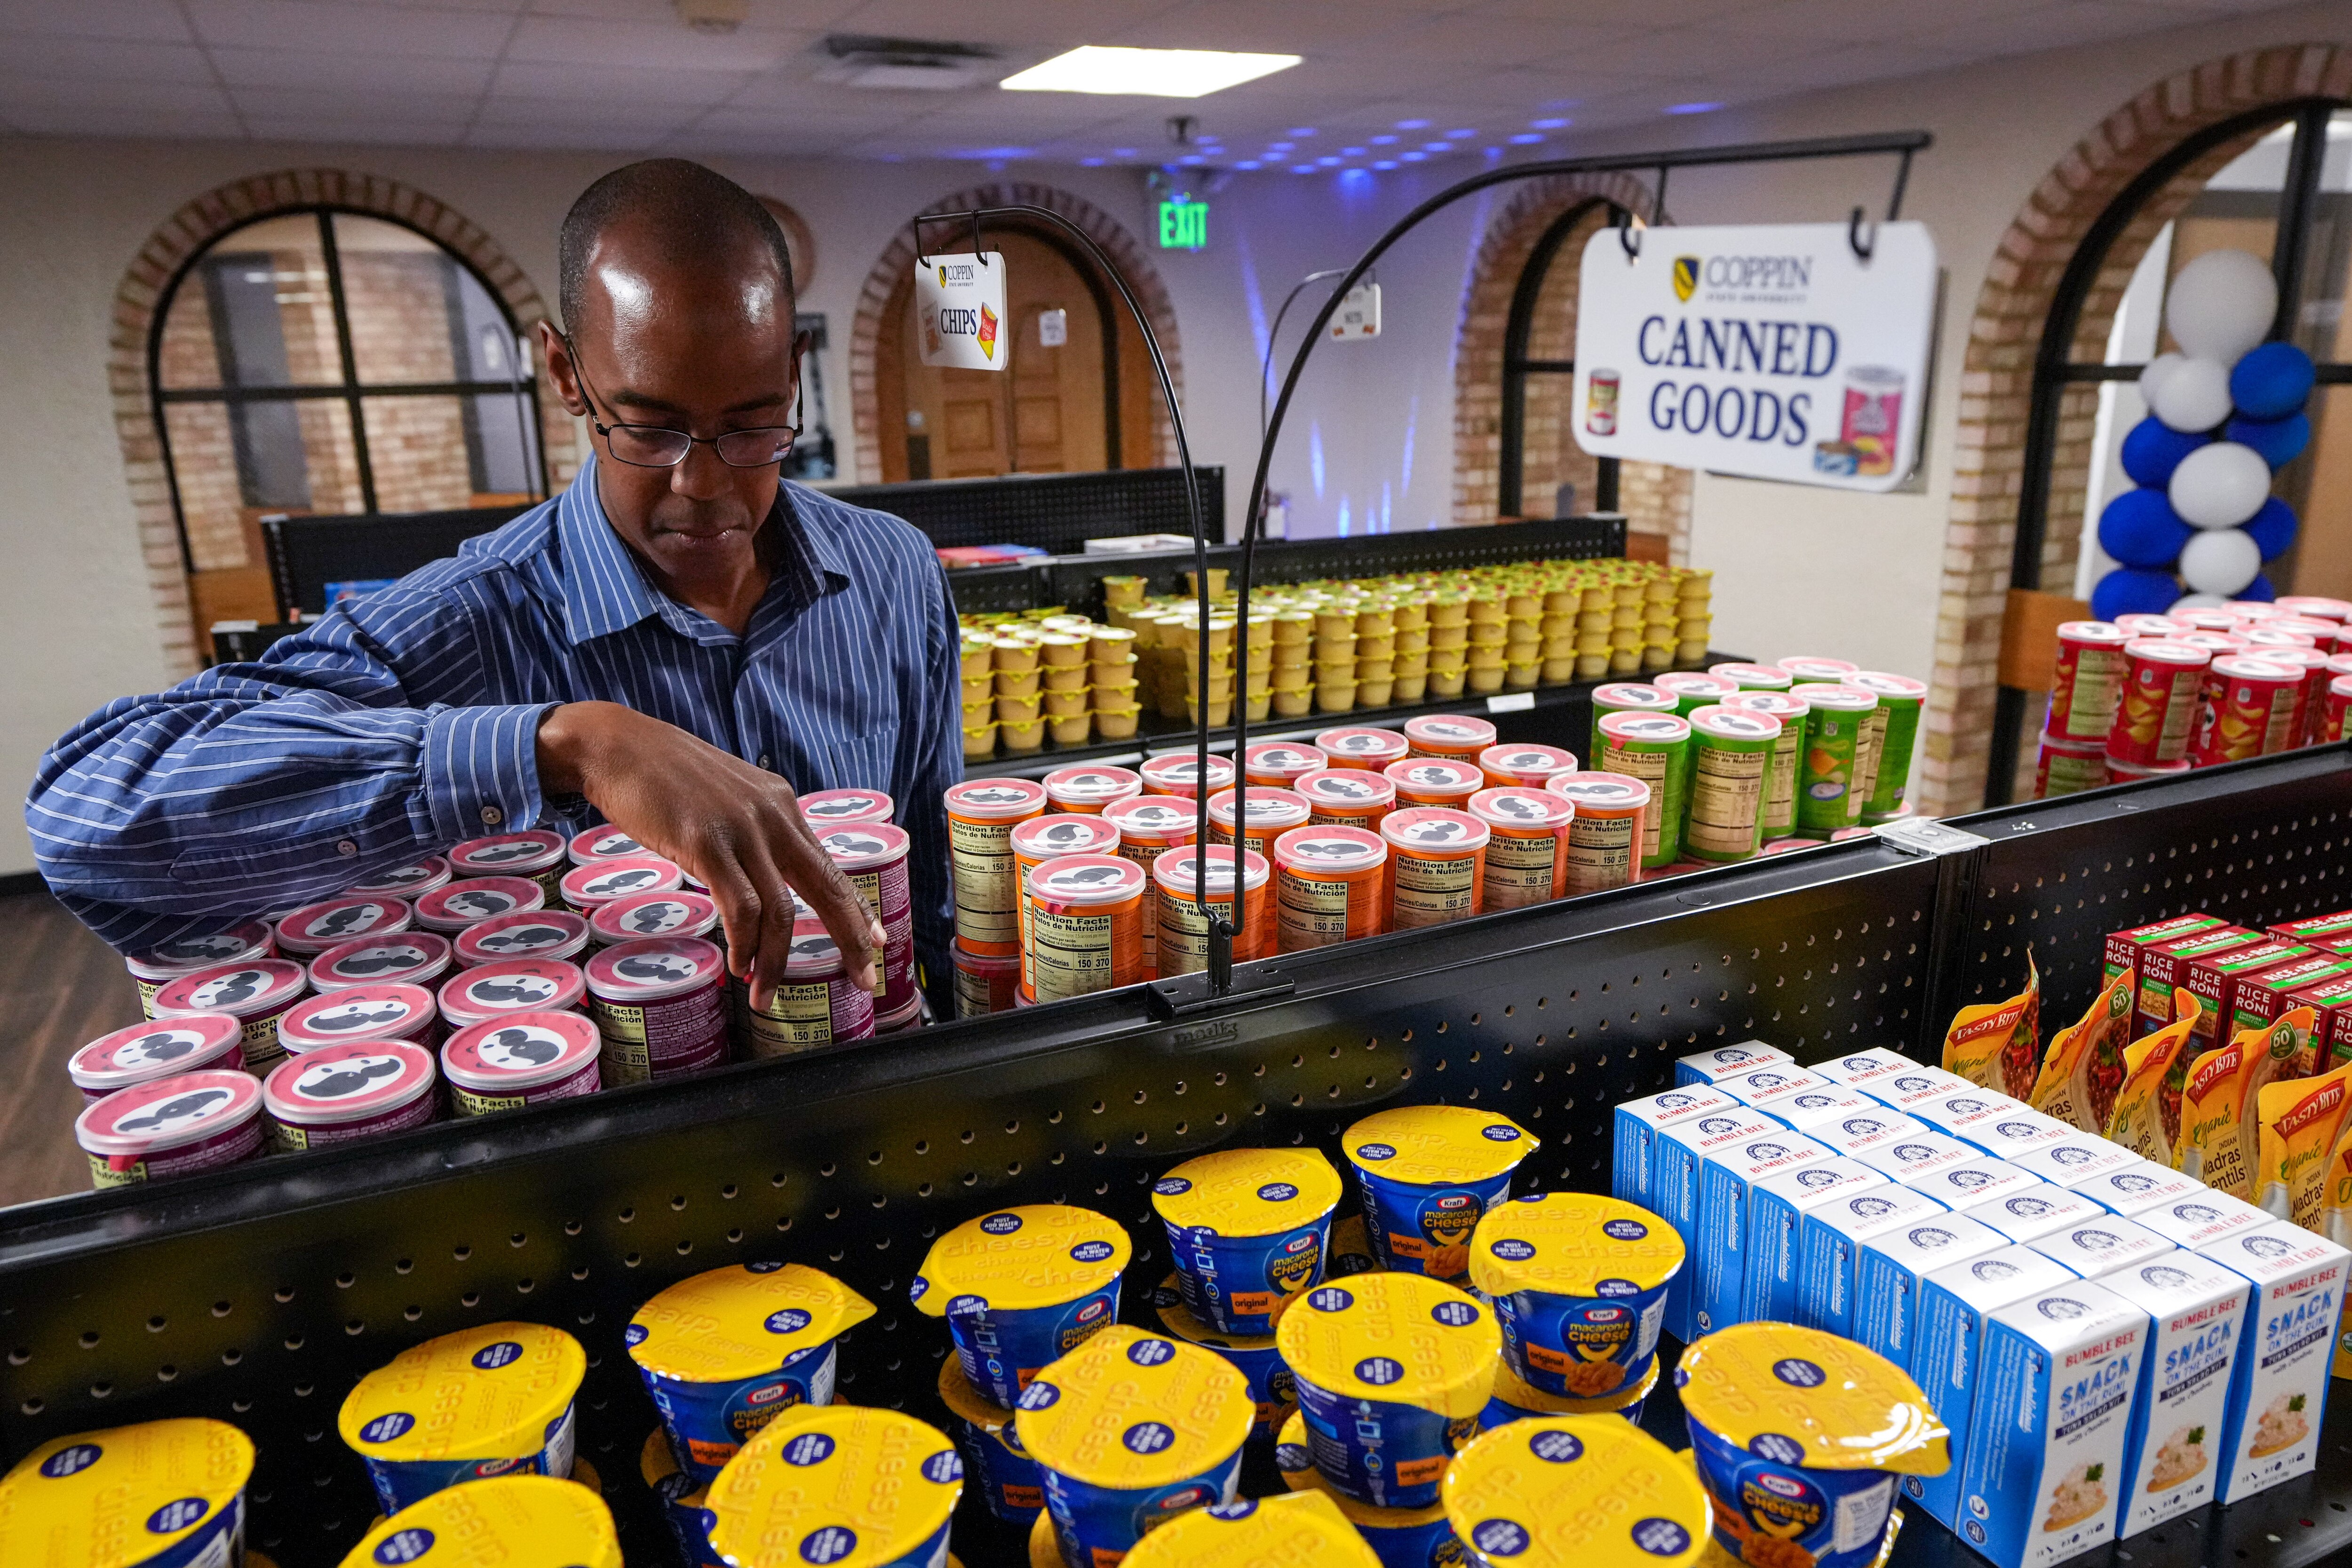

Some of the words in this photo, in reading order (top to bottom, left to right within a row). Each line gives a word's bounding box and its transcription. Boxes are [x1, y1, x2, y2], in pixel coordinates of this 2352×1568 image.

[1160, 202, 1209, 248] EXIT
[948, 265, 974, 280] COPPIN
[1706, 256, 1812, 288] COPPIN
[941, 309, 977, 335] CHIPS
[1637, 314, 1839, 378] CANNED
[1650, 381, 1811, 447] GOODS
[1605, 746, 1639, 759] Nutrition
[1701, 747, 1739, 759] Nutrition
[1398, 856, 1444, 868] Nutrition
[1448, 859, 1473, 868] Facts
[1398, 862, 1420, 873] Datos
[1437, 866, 1472, 875] Nutrición
[1159, 899, 1172, 911] Datos
[1396, 896, 1437, 908] Calories/Calorías
[1460, 897, 1470, 906] 370
[1034, 907, 1073, 924] Nutrition
[1034, 915, 1050, 926] Datos
[2107, 939, 2135, 955] RICE
[1096, 958, 1109, 967] 370
[2145, 953, 2174, 970] RICE
[2147, 979, 2166, 988] CHEDDAR
[2191, 968, 2221, 986] RICE
[2113, 993, 2127, 1010] 60
[2238, 984, 2271, 1003] RICE
[608, 1006, 641, 1015] Facts
[794, 1031, 808, 1041] 150
[814, 1029, 829, 1039] 370
[1956, 1018, 1997, 1040] TASTY
[2273, 1029, 2290, 1047] 60
[614, 1051, 627, 1062] 150
[631, 1053, 646, 1064] 370
[1715, 1060, 1757, 1073] BUMBLE
[1757, 1054, 1777, 1063] BEE
[2214, 1051, 2237, 1075] BITE
[1848, 1068, 1889, 1082] BUMBLE
[1887, 1062, 1907, 1073] BEE
[1751, 1084, 1792, 1099] BUMBLE
[1793, 1077, 1812, 1088] BEE
[1899, 1088, 1943, 1103] BUMBLE
[1942, 1082, 1962, 1092] BEE
[1656, 1105, 1699, 1120] BUMBLE
[1700, 1098, 1722, 1107] BEE
[2281, 1102, 2318, 1134] TASTY
[2319, 1087, 2341, 1111] BITE
[1700, 1130, 1744, 1146] BUMBLE
[1745, 1123, 1768, 1134] BEE
[2219, 1136, 2237, 1150] INDIAN
[1749, 1156, 1796, 1173] BUMBLE
[1796, 1149, 1817, 1160] BEE
[1899, 1157, 1944, 1175] BUMBLE
[1943, 1149, 1967, 1161] BEE
[2103, 1154, 2127, 1164] BEE
[2203, 1147, 2241, 1178] Madras
[2306, 1170, 2321, 1186] INDIAN
[2167, 1182, 2189, 1194] BEE
[1425, 1210, 1471, 1218] macaroni
[2188, 1220, 2233, 1241] BUMBLE
[2232, 1212, 2256, 1226] BEE
[1292, 1239, 1308, 1249] Kraft
[1393, 1241, 1422, 1251] original
[1274, 1248, 1314, 1266] macaroni
[2254, 1256, 2304, 1276] BUMBLE
[2302, 1246, 2330, 1261] BEE
[2273, 1274, 2317, 1299] BUMBLE
[2318, 1266, 2339, 1283] BEE
[1235, 1297, 1268, 1309] original
[1082, 1305, 1099, 1319] Kraft
[2171, 1306, 2217, 1332] BUMBLE
[2218, 1297, 2238, 1314] BEE
[2267, 1287, 2334, 1340] SNACK
[1570, 1322, 1623, 1332] macaroni
[2285, 1328, 2303, 1342] THE
[2066, 1340, 2111, 1368] BUMBLE
[2115, 1329, 2137, 1348] BEE
[2165, 1318, 2233, 1373] SNACK
[1530, 1352, 1564, 1366] original
[2060, 1352, 2132, 1409] SNACK
[756, 1389, 778, 1401] Kraft
[485, 1460, 510, 1473] Kraft
